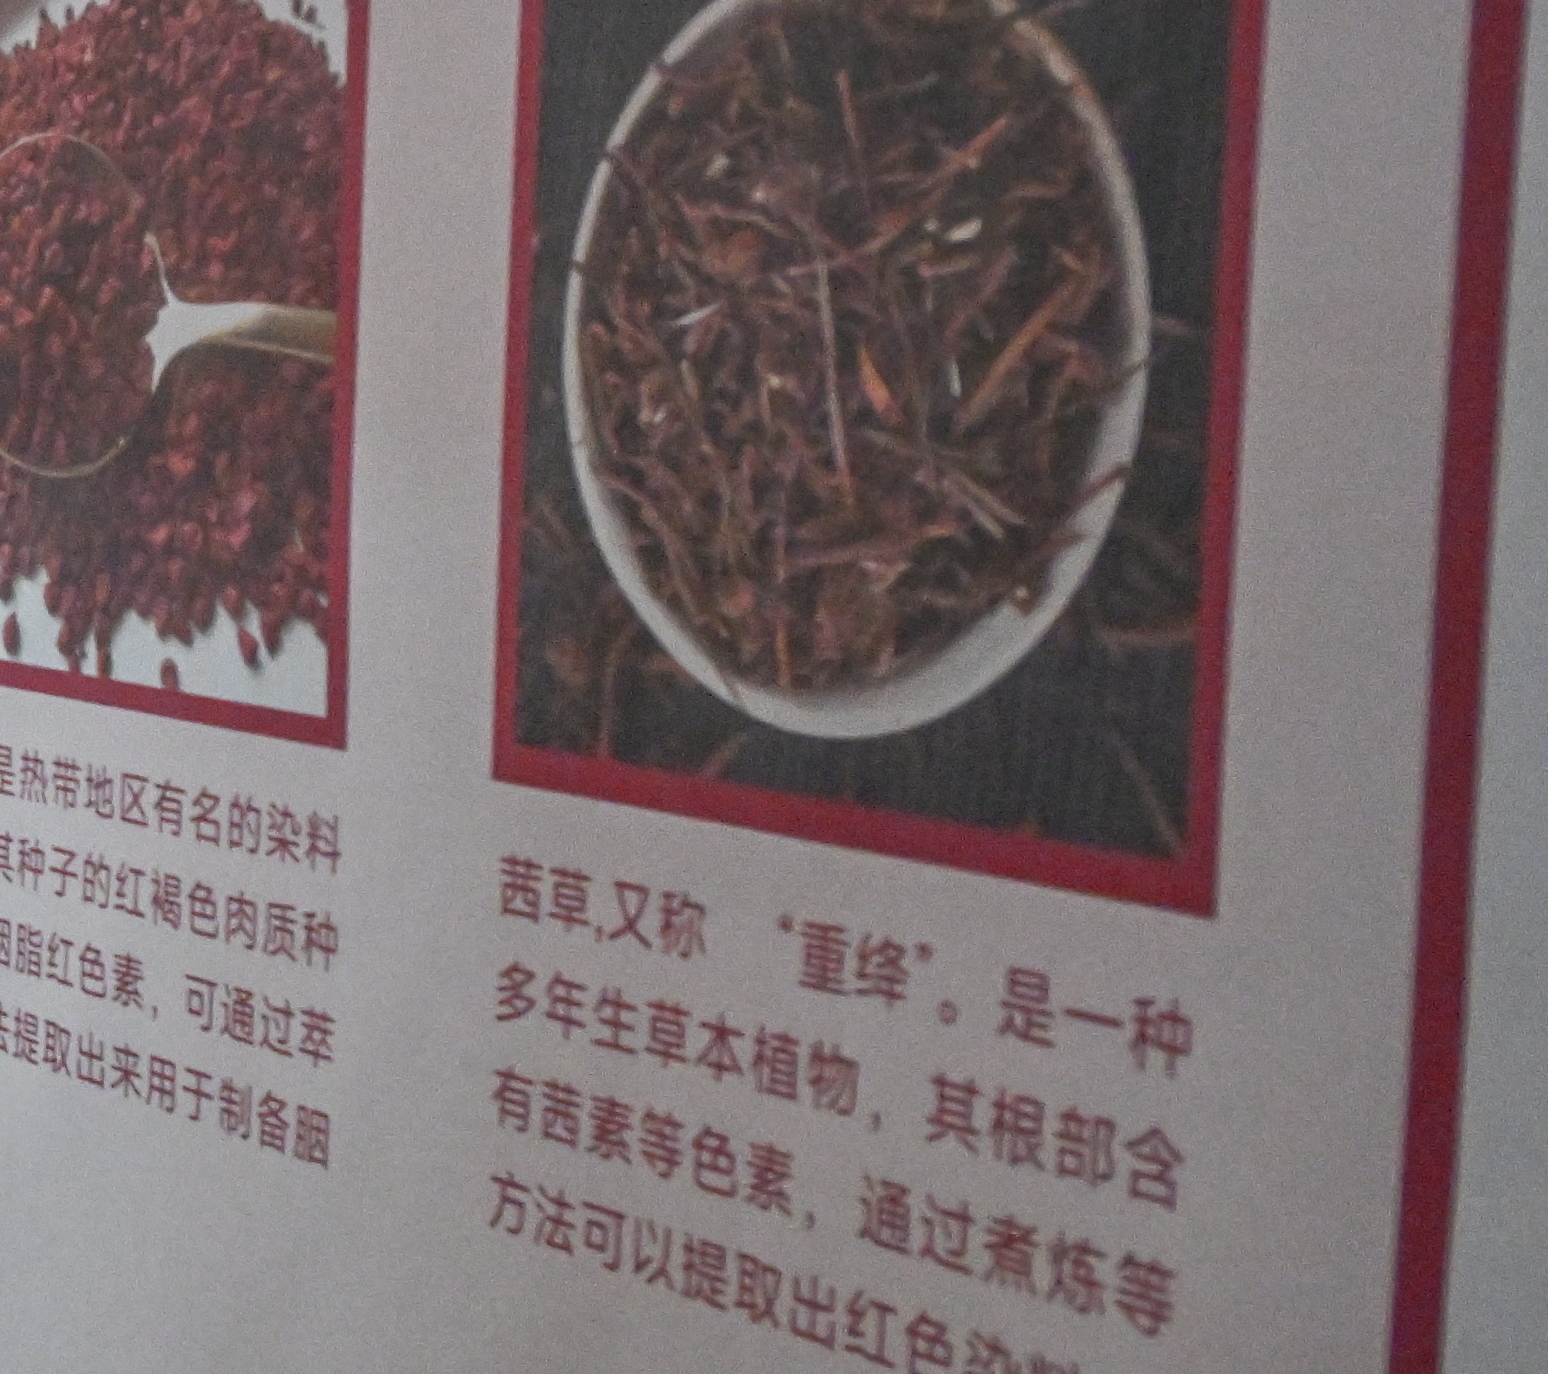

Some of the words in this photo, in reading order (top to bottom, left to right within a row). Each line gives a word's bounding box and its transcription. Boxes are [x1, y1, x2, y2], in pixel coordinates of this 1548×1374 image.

[491, 1065, 1179, 1340] 有茜素等色素，通过煮炼等
[494, 961, 1187, 1213] 多年生草本植物，其根部含
